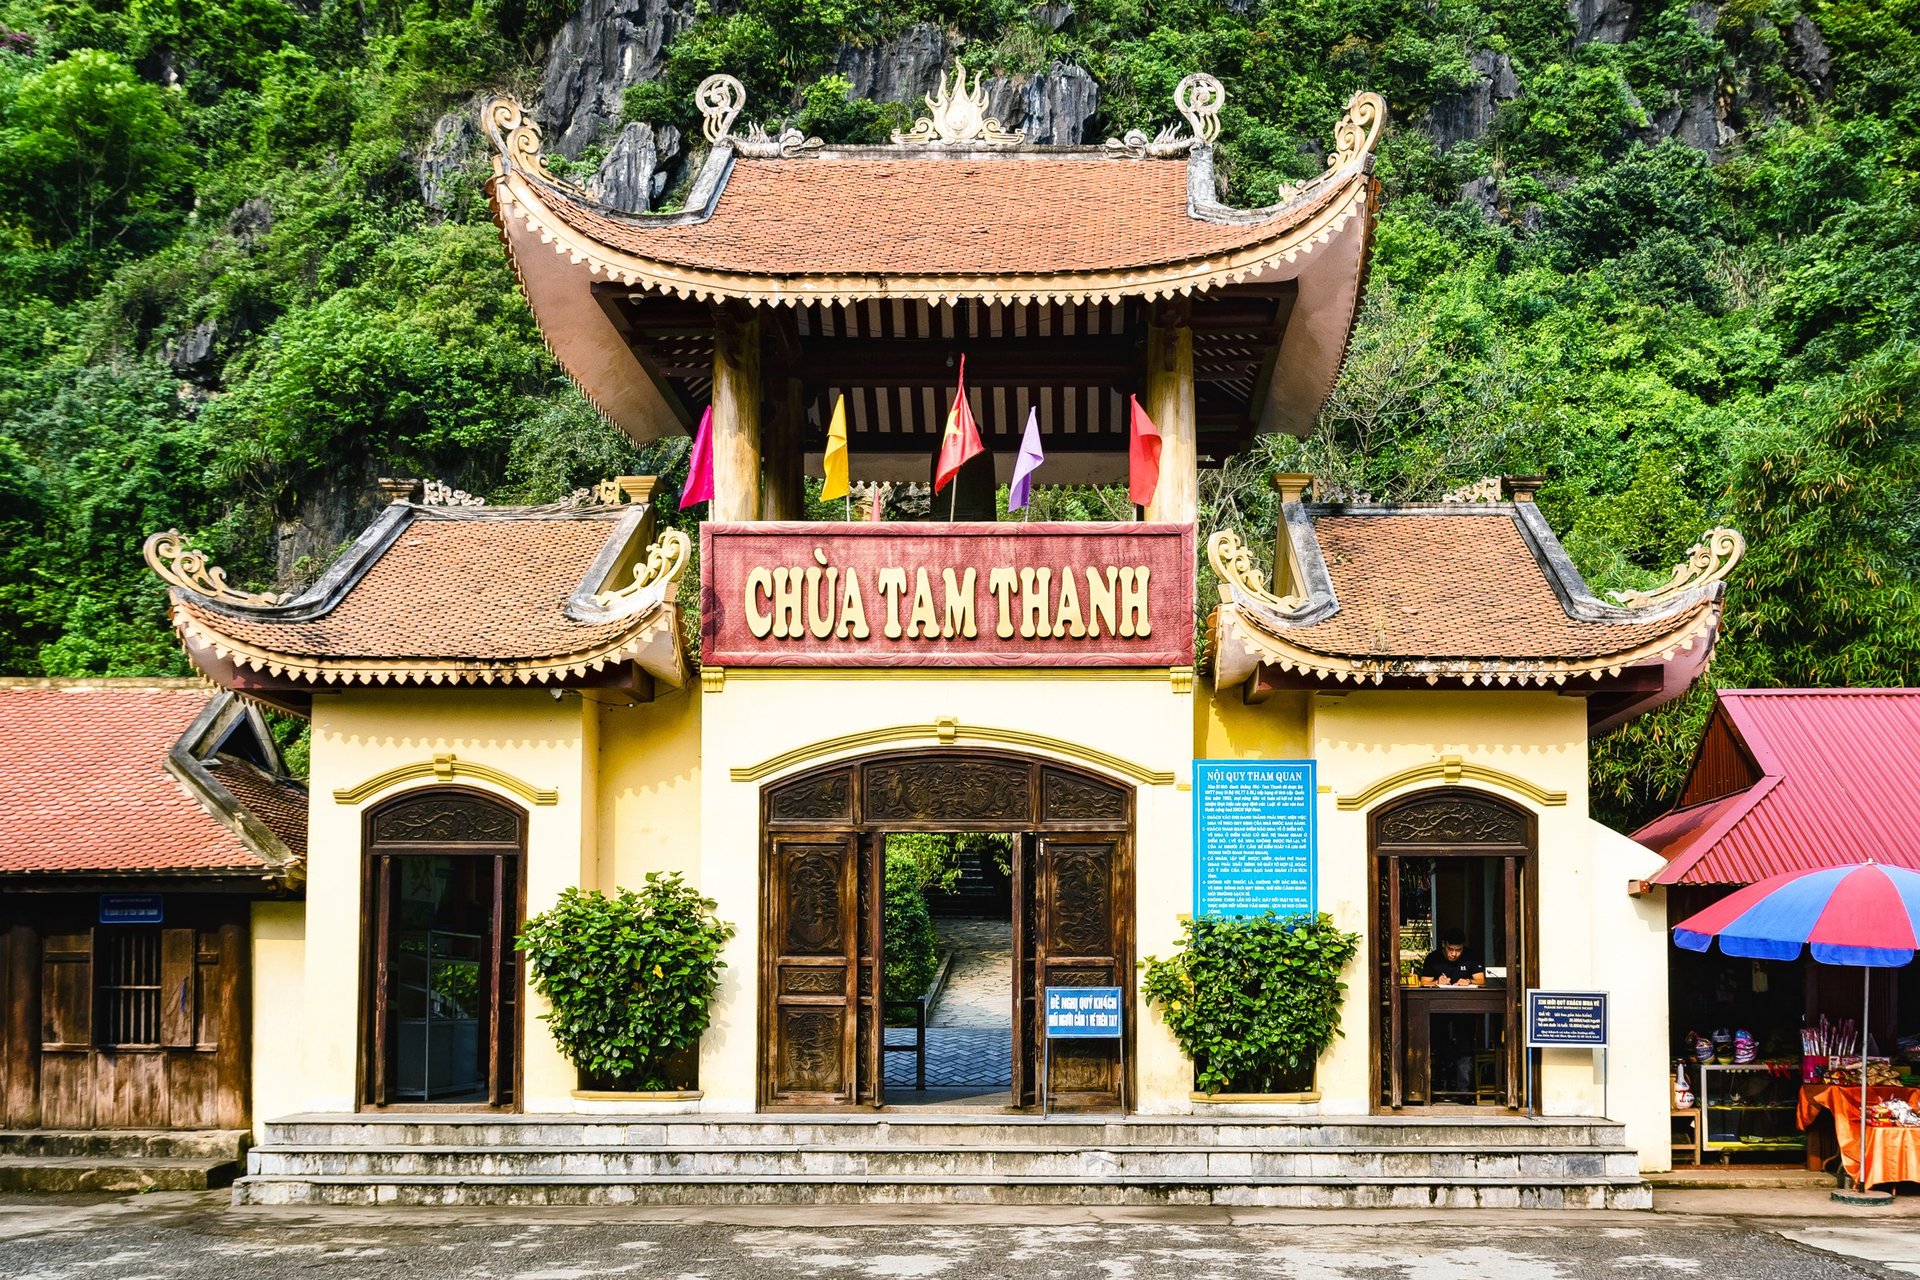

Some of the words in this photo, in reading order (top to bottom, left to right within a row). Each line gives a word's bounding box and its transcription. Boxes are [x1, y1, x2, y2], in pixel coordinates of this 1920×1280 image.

[745, 547, 870, 639] CHÙA
[878, 566, 978, 639] TAM
[990, 565, 1152, 638] THANH
[1207, 768, 1225, 783] NỘI
[1226, 771, 1245, 782] QUY
[1247, 771, 1274, 781] THAM
[1275, 771, 1302, 782] QUAN
[1061, 997, 1078, 1011] NGHỊ
[1079, 995, 1093, 1010] QUÝ
[1094, 995, 1117, 1009] KHÁCH
[1086, 1015, 1088, 1026] 1
